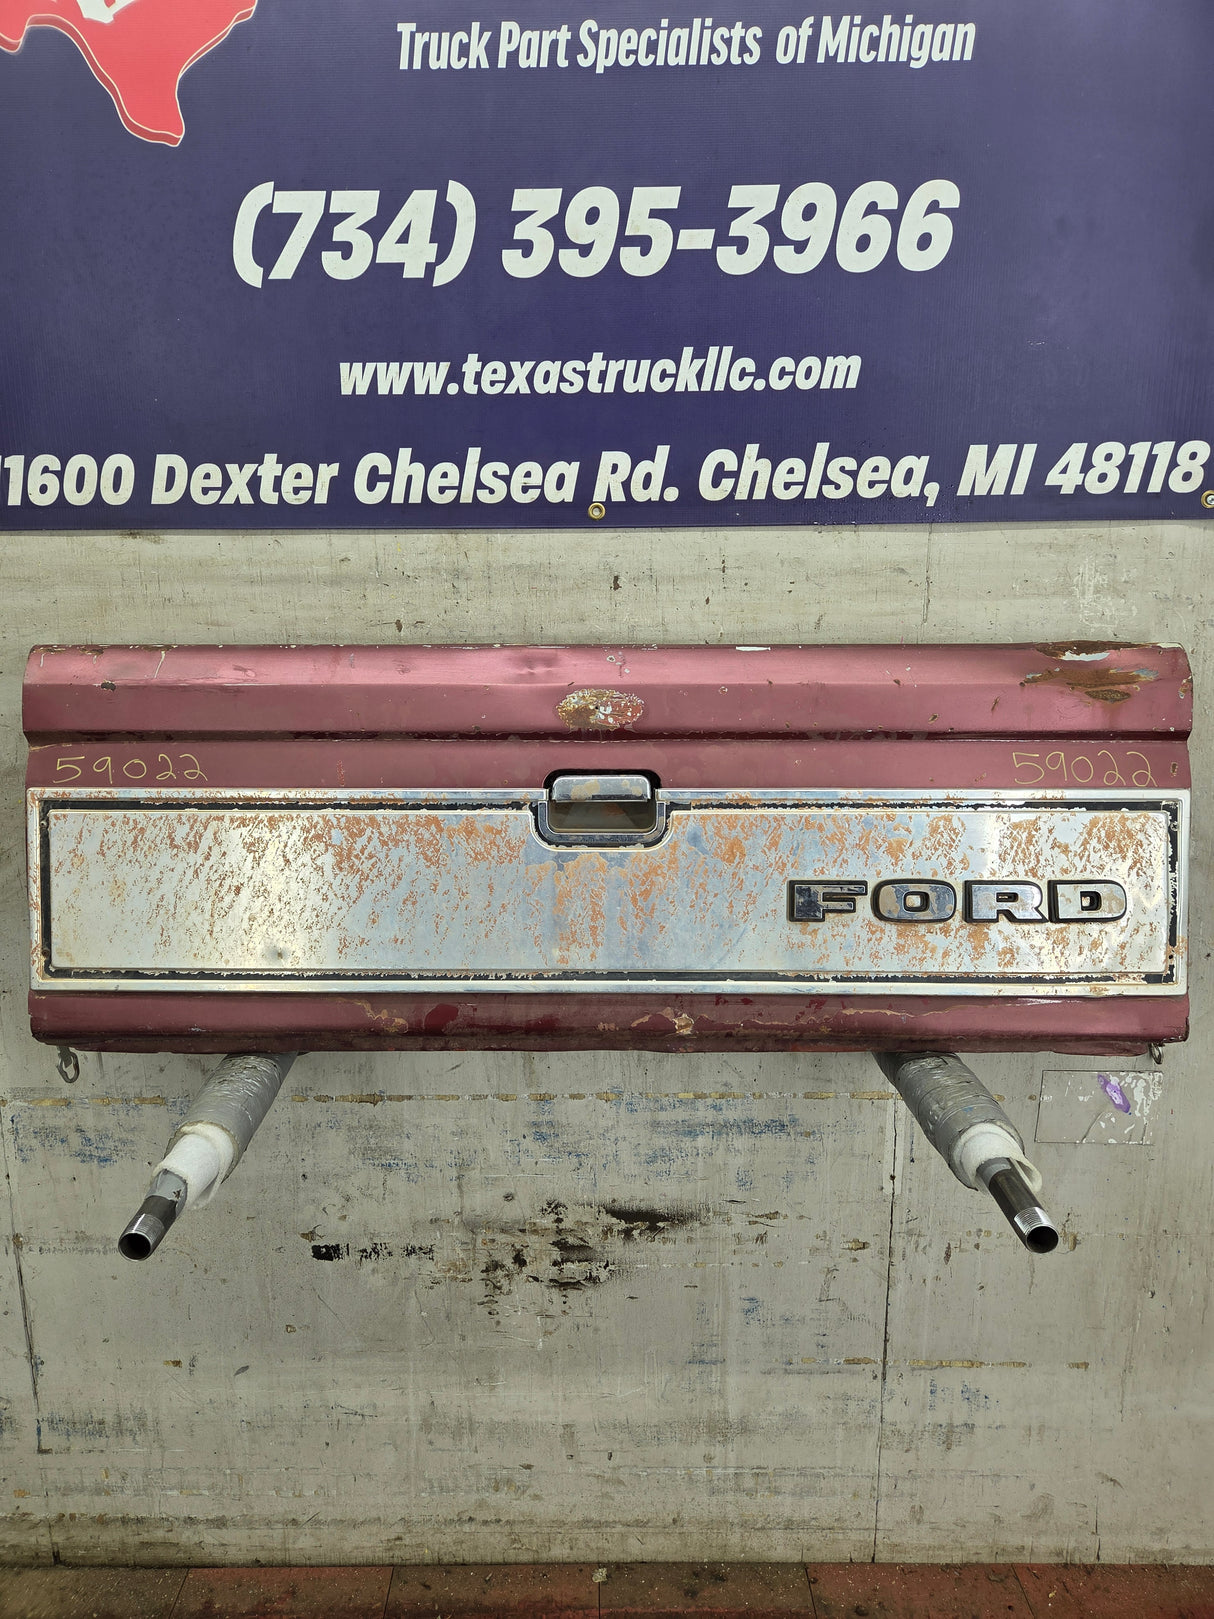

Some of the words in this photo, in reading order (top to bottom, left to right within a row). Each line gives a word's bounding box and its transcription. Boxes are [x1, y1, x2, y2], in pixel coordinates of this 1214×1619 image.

[397, 22, 492, 70] Truck
[498, 21, 571, 68] Part
[577, 18, 762, 73] Specialists
[776, 16, 814, 64] of
[817, 14, 976, 68] Michigan
[232, 180, 477, 288] (734)
[501, 180, 961, 278] 395-3966
[340, 346, 862, 395] www.texastruckllc.com
[0, 453, 135, 506] 1600
[151, 453, 339, 505] Dexter
[354, 447, 580, 504] Chelsea
[593, 445, 679, 502] Rd.
[699, 443, 940, 506] Chelsea,
[957, 444, 1037, 496] MI
[1045, 441, 1211, 495] 48118
[53, 753, 208, 785] 59022
[1012, 750, 1156, 787] 59022
[788, 879, 1128, 923] FORD
